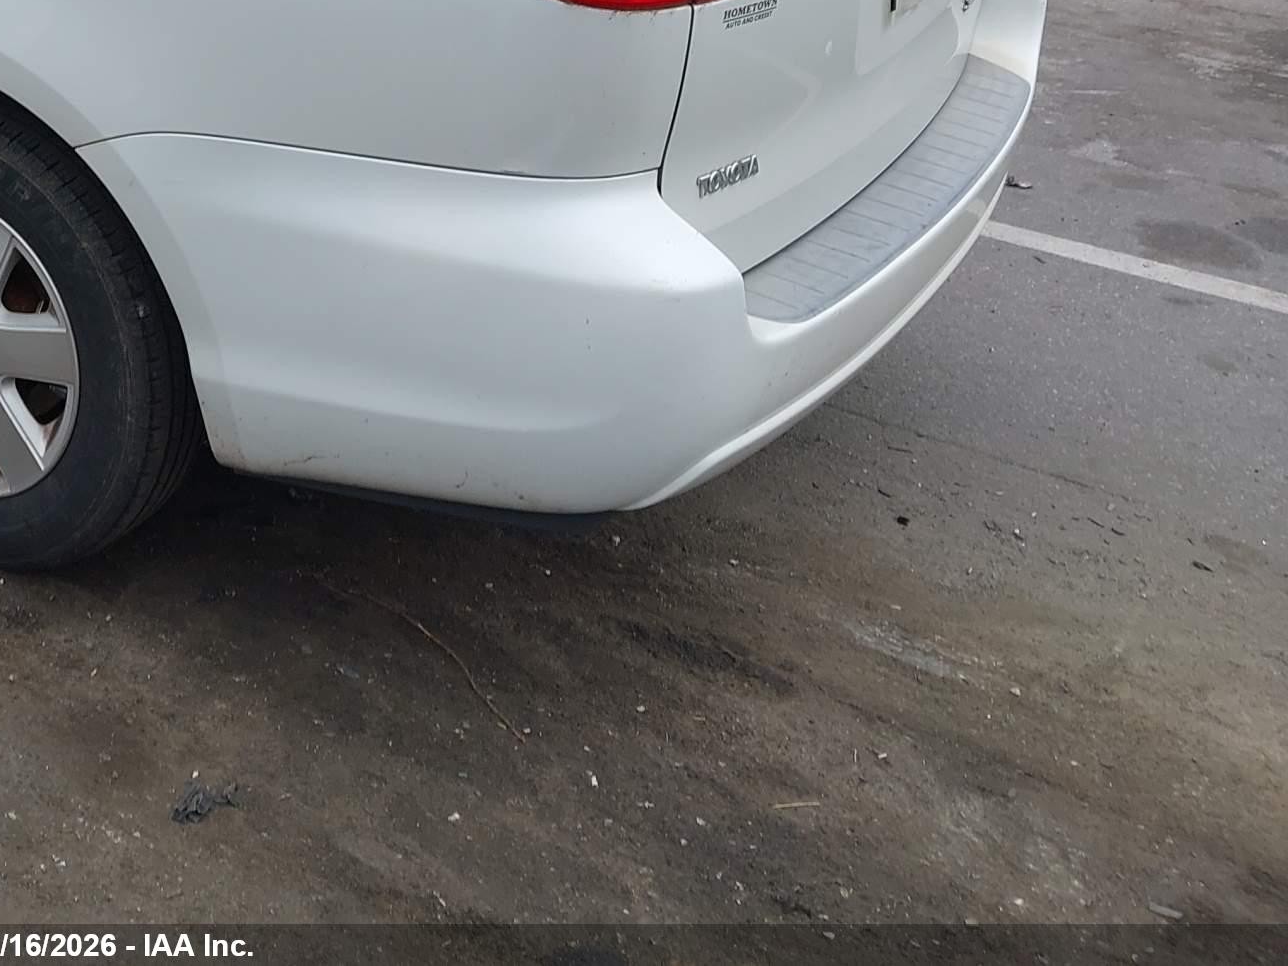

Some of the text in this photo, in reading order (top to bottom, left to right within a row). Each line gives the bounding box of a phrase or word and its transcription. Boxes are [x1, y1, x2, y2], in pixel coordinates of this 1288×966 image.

[725, 10, 773, 29] AUTO AND CREDIT
[696, 154, 759, 198] TOYOTA
